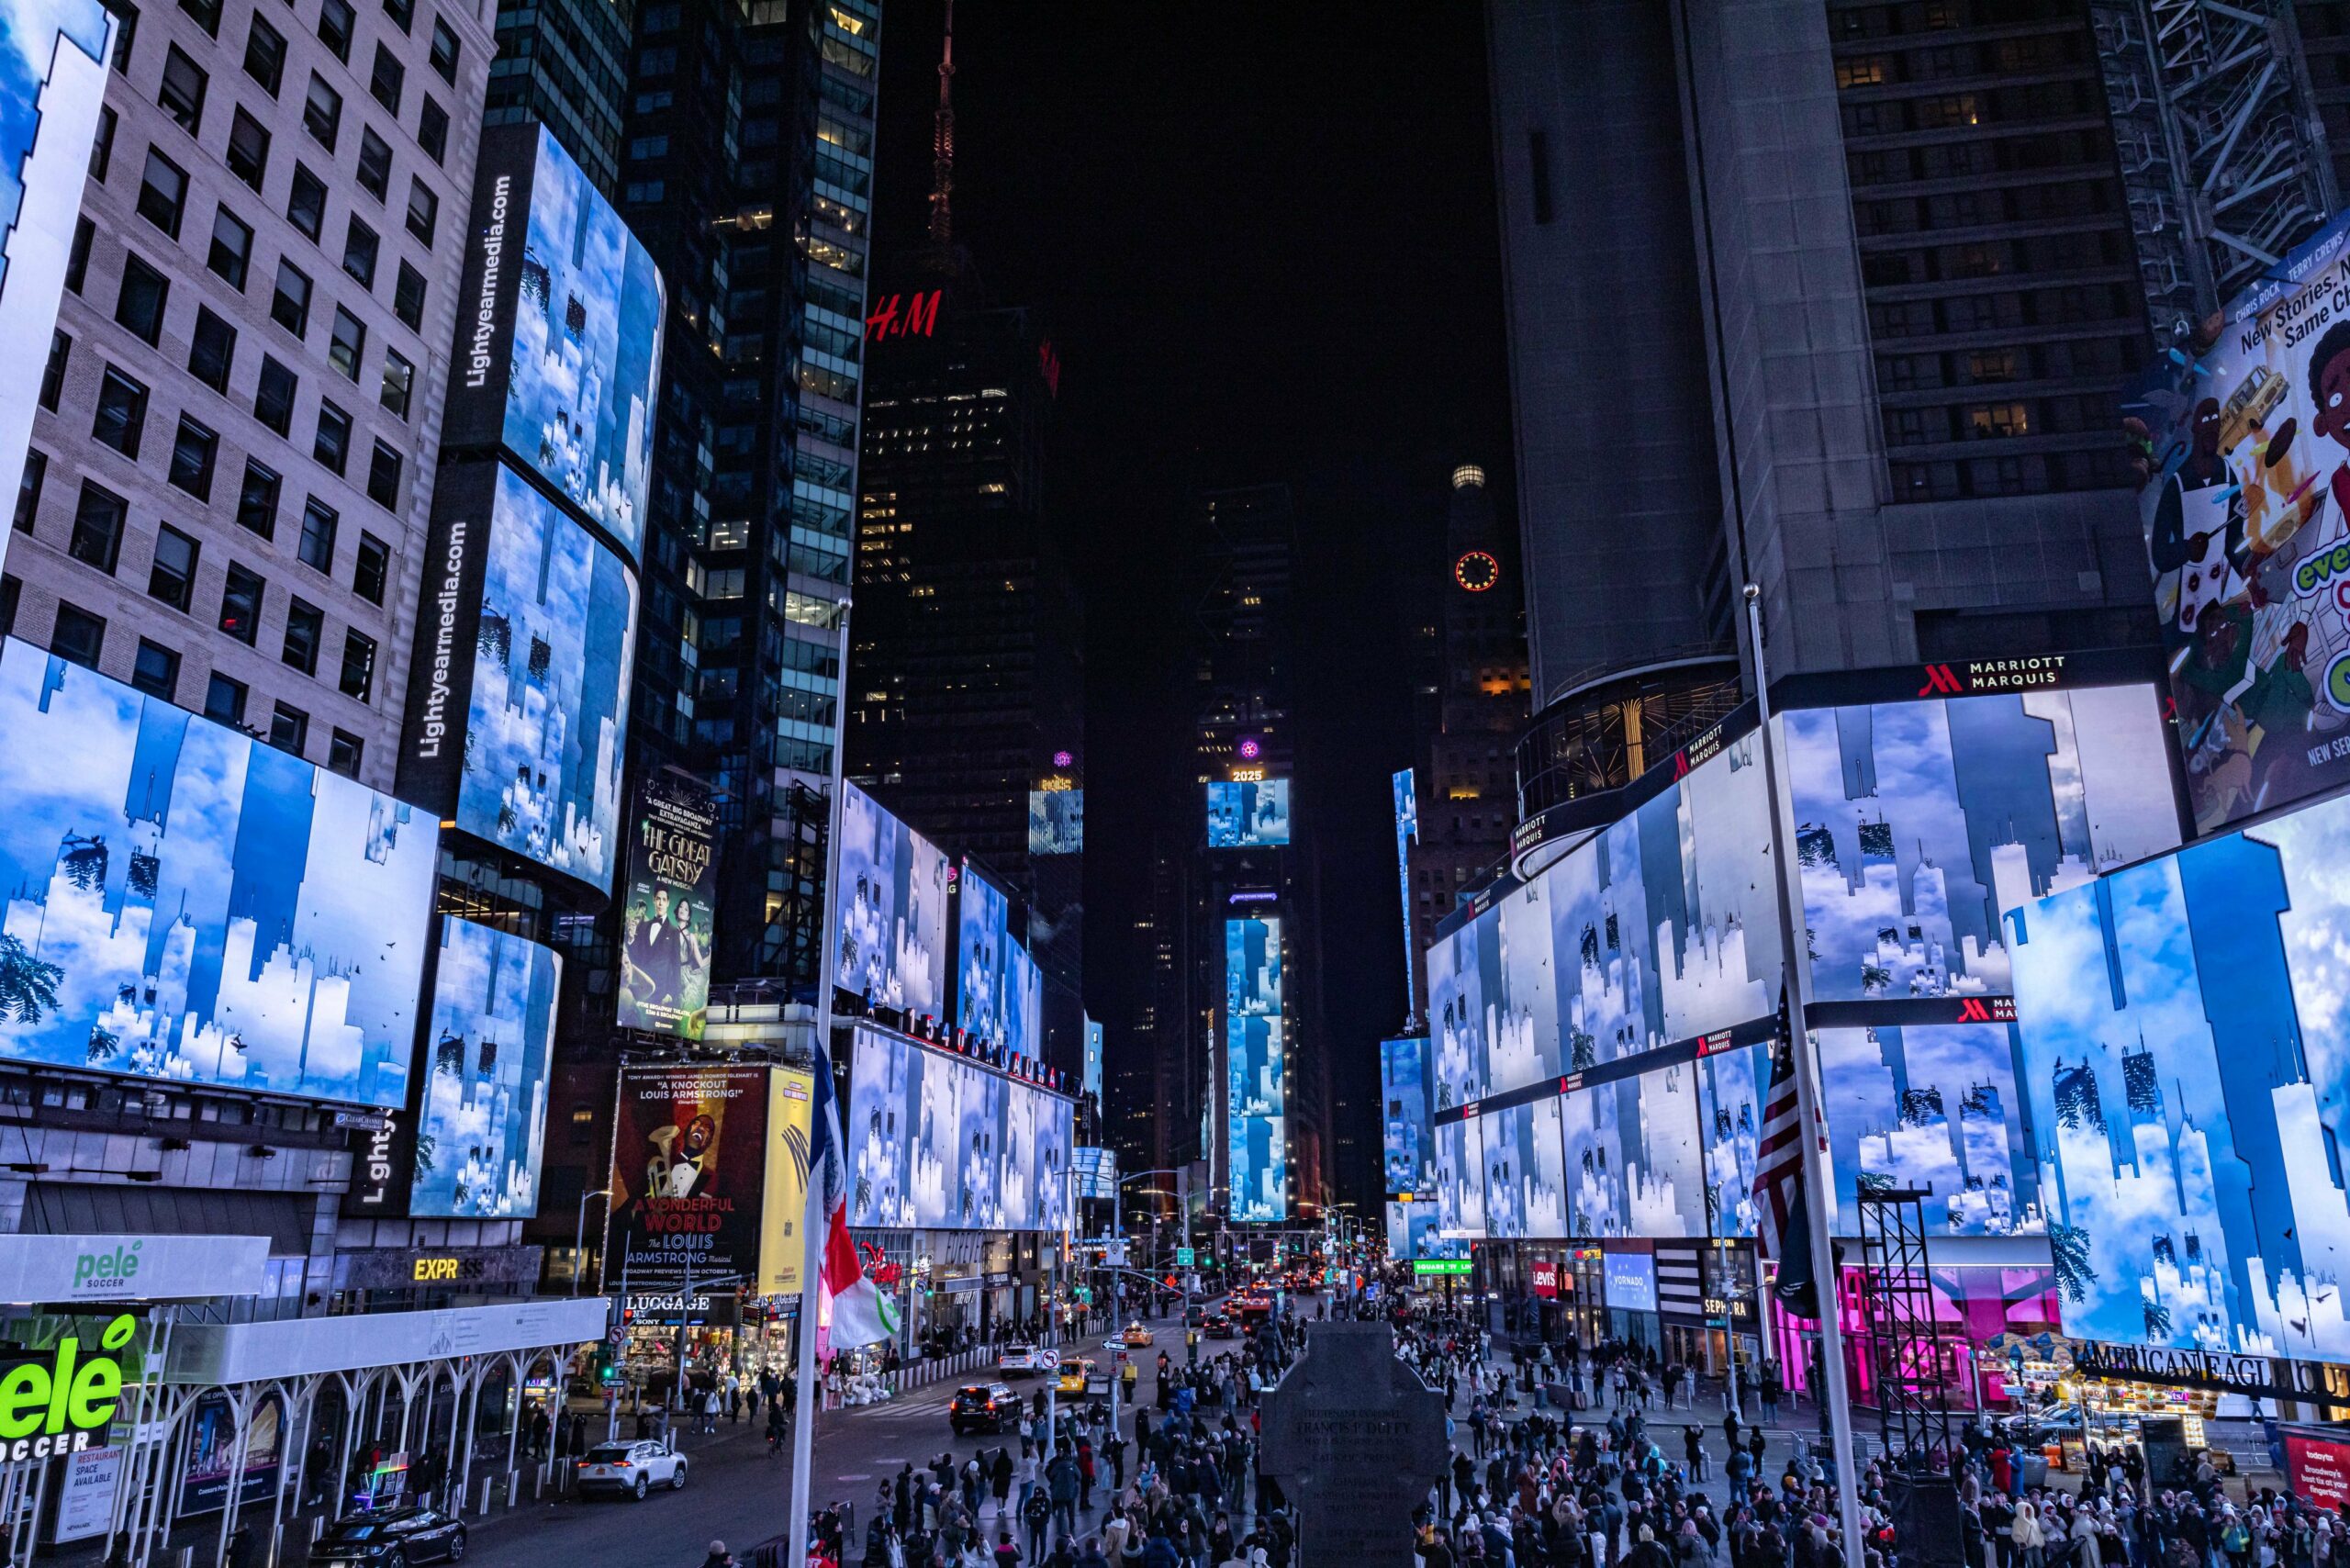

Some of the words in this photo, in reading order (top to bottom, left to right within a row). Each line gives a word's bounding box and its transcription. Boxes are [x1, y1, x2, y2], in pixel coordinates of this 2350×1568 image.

[2288, 254, 2313, 282] TERRY
[2315, 231, 2344, 263] CREWS
[466, 175, 510, 387] Lightyearmedia.com
[2234, 298, 2258, 324] CHRIS
[2259, 280, 2280, 306] ROCK
[865, 289, 943, 342] H&M
[2241, 320, 2272, 355] New
[2275, 275, 2338, 329] Stories.
[2284, 306, 2330, 349] Same
[420, 521, 466, 758] Lightyearmedia.com
[1970, 655, 2065, 675] MARRIOTT
[1972, 672, 2057, 689] MARQUIS
[1689, 723, 1722, 755] MARRIOTT
[1690, 740, 1719, 767] MARQUIS
[2307, 744, 2330, 767] NEW
[1233, 770, 1263, 782] 2025
[659, 809, 702, 831] EXTRAVAGANZA
[672, 805, 683, 815] BIG
[683, 809, 713, 826] BROADWAY
[1516, 814, 1546, 839] MARRIOTT
[643, 823, 667, 852] THE
[668, 834, 712, 867] GREAT
[1516, 829, 1542, 853] MARQUIS
[648, 850, 704, 885] GATSBY
[661, 876, 672, 885] NEW
[1707, 1029, 1732, 1043] MARRIOTT
[1708, 1039, 1730, 1052] MARQUIS
[640, 1090, 670, 1100] LOUIS
[671, 1080, 728, 1090] KNOCKOUT
[646, 1198, 735, 1212] WONDERFUL
[644, 1213, 722, 1233] WORLD
[663, 1233, 714, 1249] LOUIS
[73, 1239, 142, 1288] pelé
[625, 1251, 707, 1264] ARMSTRONG
[86, 1278, 125, 1288] SOCCER
[1614, 1275, 1644, 1286] VORNADO
[625, 1296, 711, 1311] LUGGAGE
[2078, 1340, 2201, 1379] AMERICAN
[73, 1472, 112, 1487] AVAILABLE
[75, 1464, 98, 1476] SPACE
[2304, 1463, 2342, 1479] Broadway's
[198, 1485, 218, 1495] Caesars
[2300, 1473, 2316, 1484] best
[2315, 1477, 2325, 1485] tix
[2333, 1481, 2348, 1489] your
[2309, 1484, 2344, 1499] fingertips.
